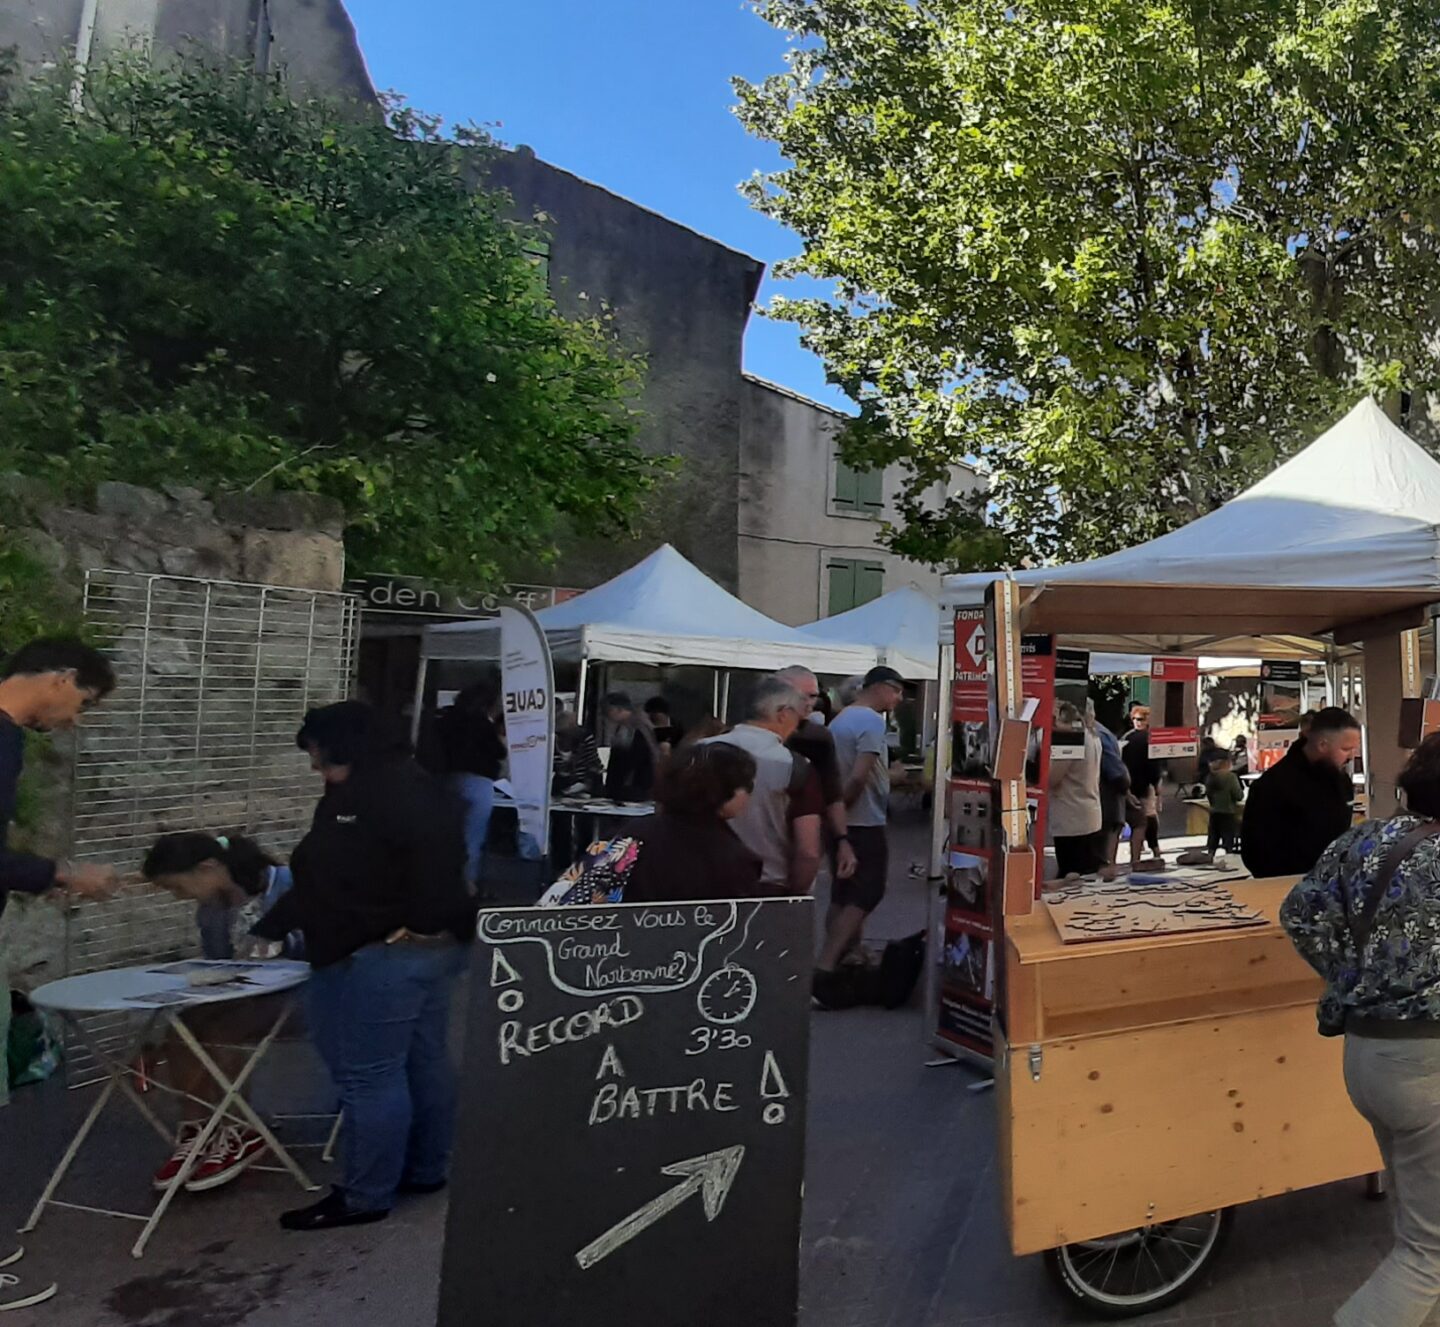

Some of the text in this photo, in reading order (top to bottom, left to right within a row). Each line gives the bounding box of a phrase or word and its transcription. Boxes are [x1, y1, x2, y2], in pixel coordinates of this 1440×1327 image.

[956, 610, 985, 620] FONDA
[484, 912, 623, 934] Connaissez
[558, 932, 630, 960] Grand
[499, 995, 645, 1064] RECORD
[596, 1043, 625, 1080] A
[588, 1078, 740, 1126] BATTRE
